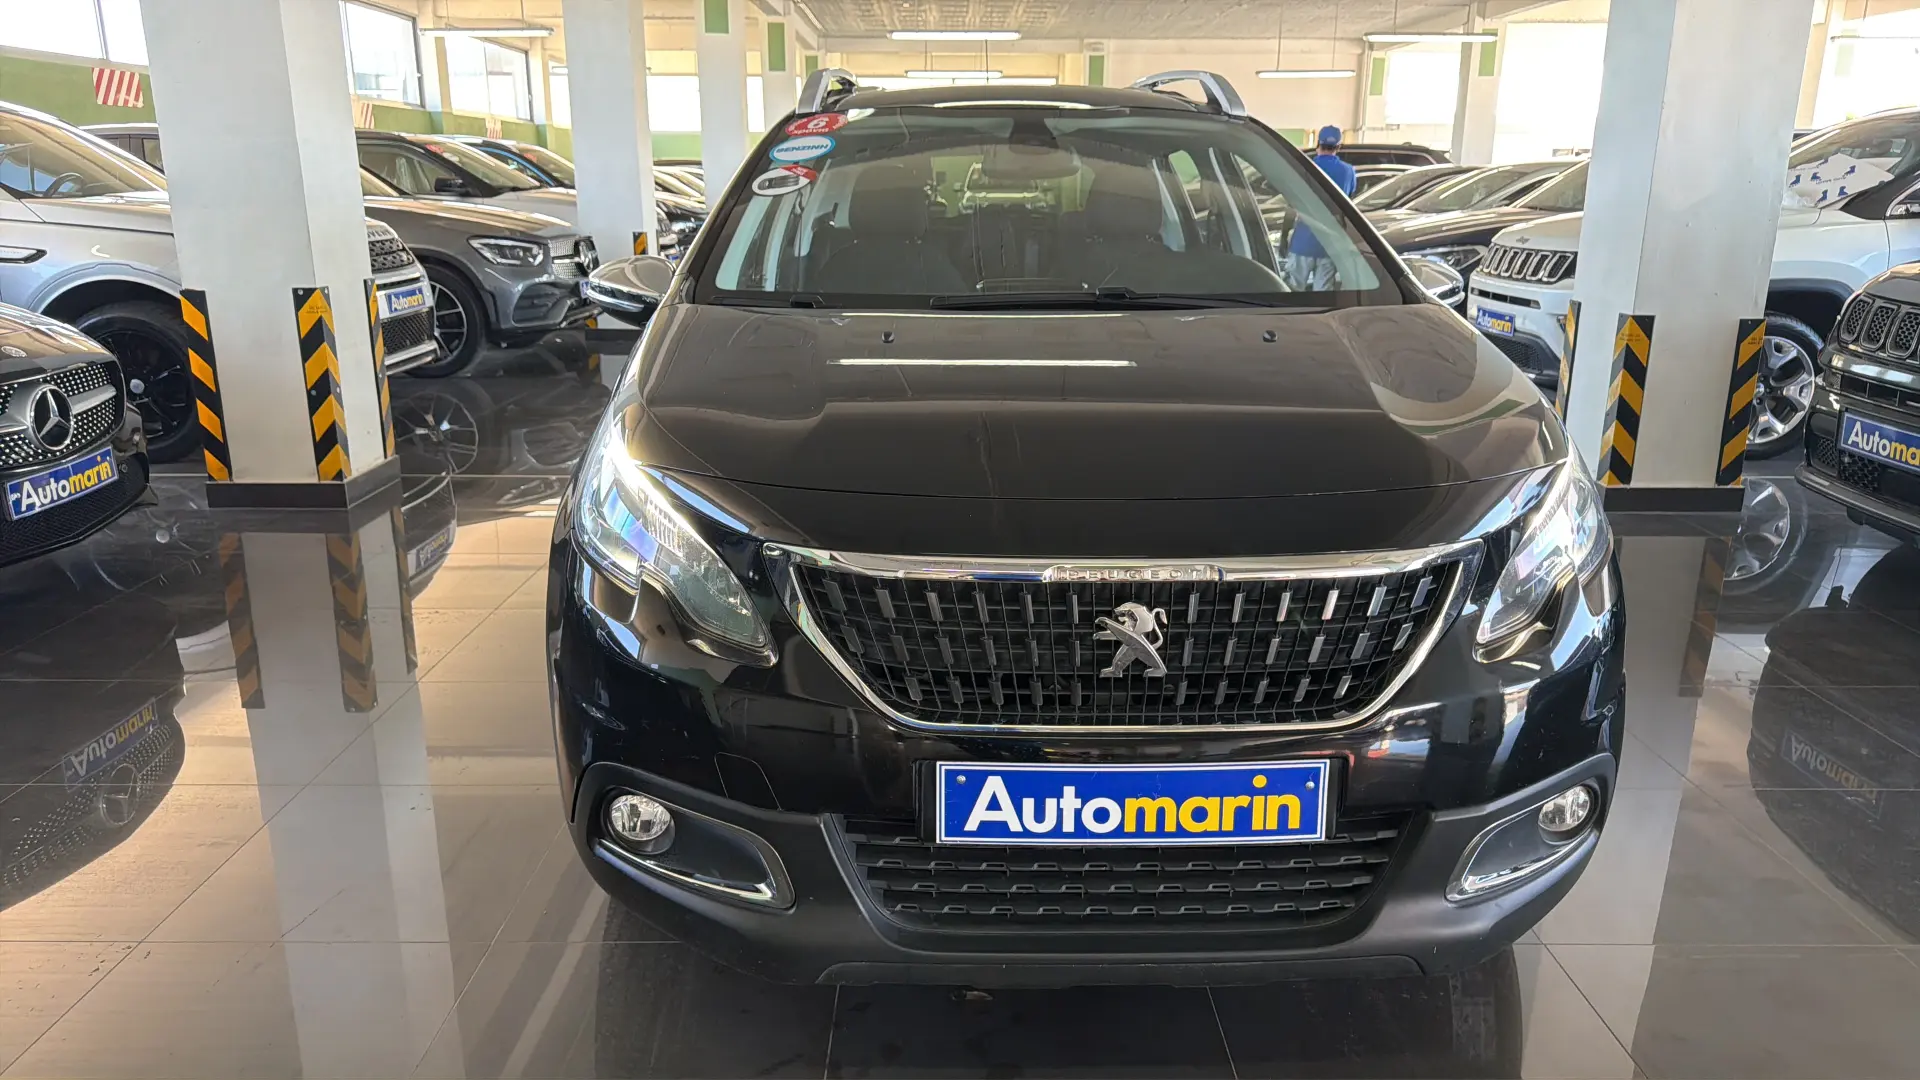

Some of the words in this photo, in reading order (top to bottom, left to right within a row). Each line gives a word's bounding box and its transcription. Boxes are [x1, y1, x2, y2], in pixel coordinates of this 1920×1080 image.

[807, 117, 829, 129] 6
[391, 289, 424, 313] Automarin
[1477, 309, 1512, 333] Automarin
[21, 455, 112, 512] Automarin
[1066, 569, 1202, 579] PEUGEOT
[963, 774, 1301, 834] Automarin
